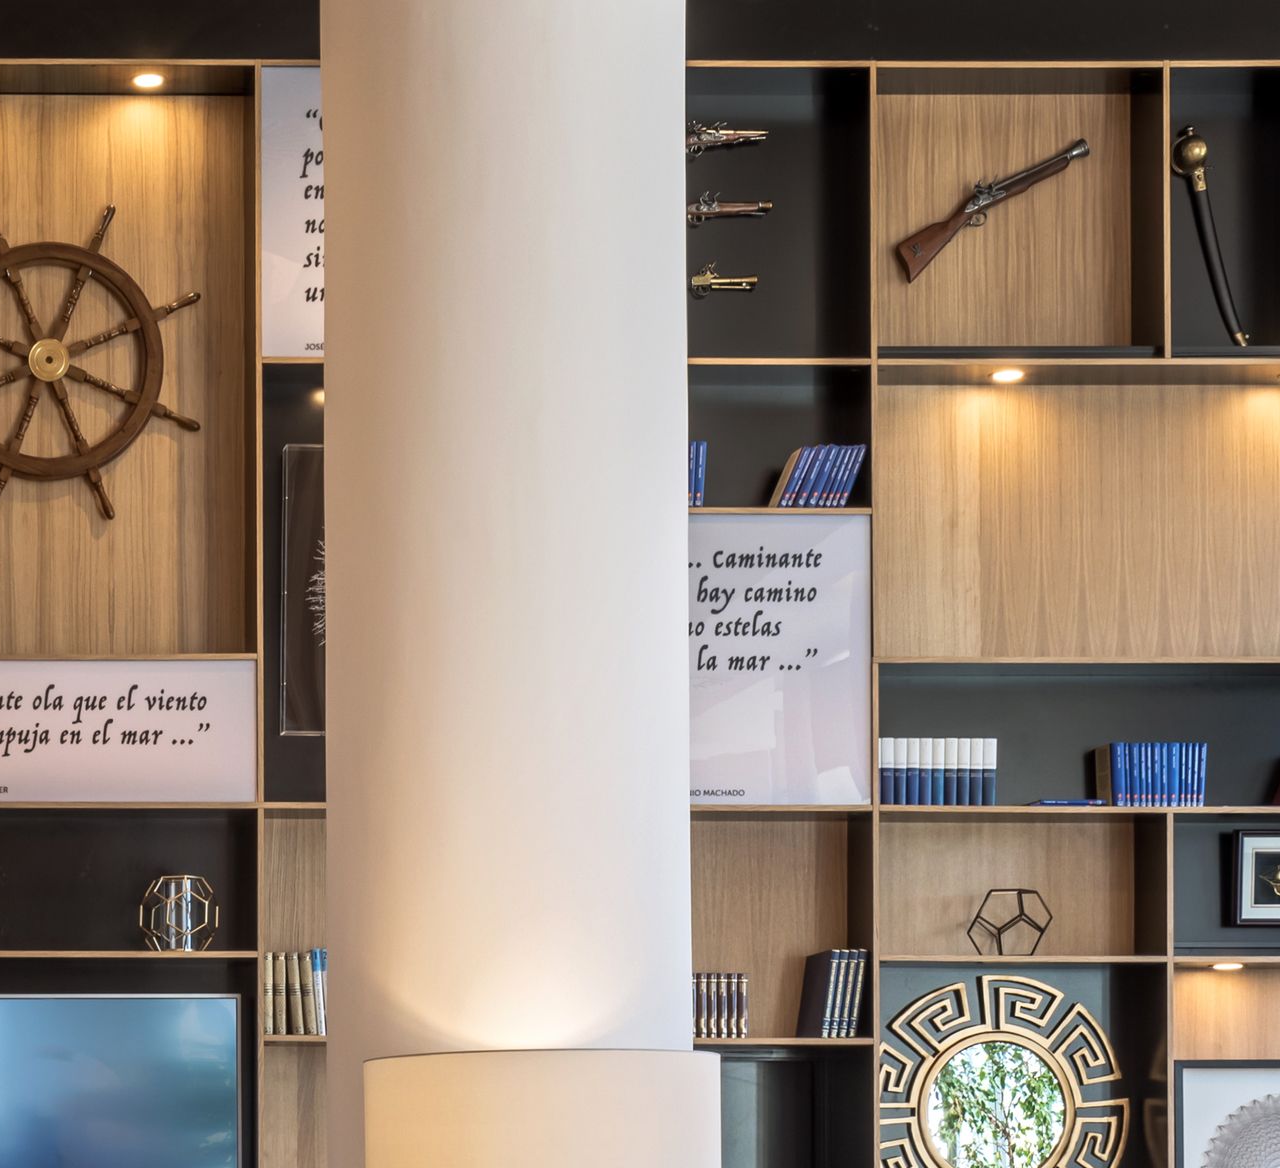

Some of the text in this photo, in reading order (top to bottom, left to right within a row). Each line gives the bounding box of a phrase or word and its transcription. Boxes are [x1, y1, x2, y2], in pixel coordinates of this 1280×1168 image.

[713, 546, 822, 568] Caminante
[697, 576, 817, 614] hay camino
[715, 611, 781, 636] estelas
[698, 645, 717, 671] la
[728, 656, 770, 671] mar
[33, 684, 63, 710] ola
[72, 696, 106, 723] que
[117, 685, 138, 710] el
[145, 689, 207, 711] viento
[60, 730, 81, 744] en
[92, 719, 113, 744] el
[121, 730, 163, 745] mar
[703, 789, 746, 797] MACHADO
